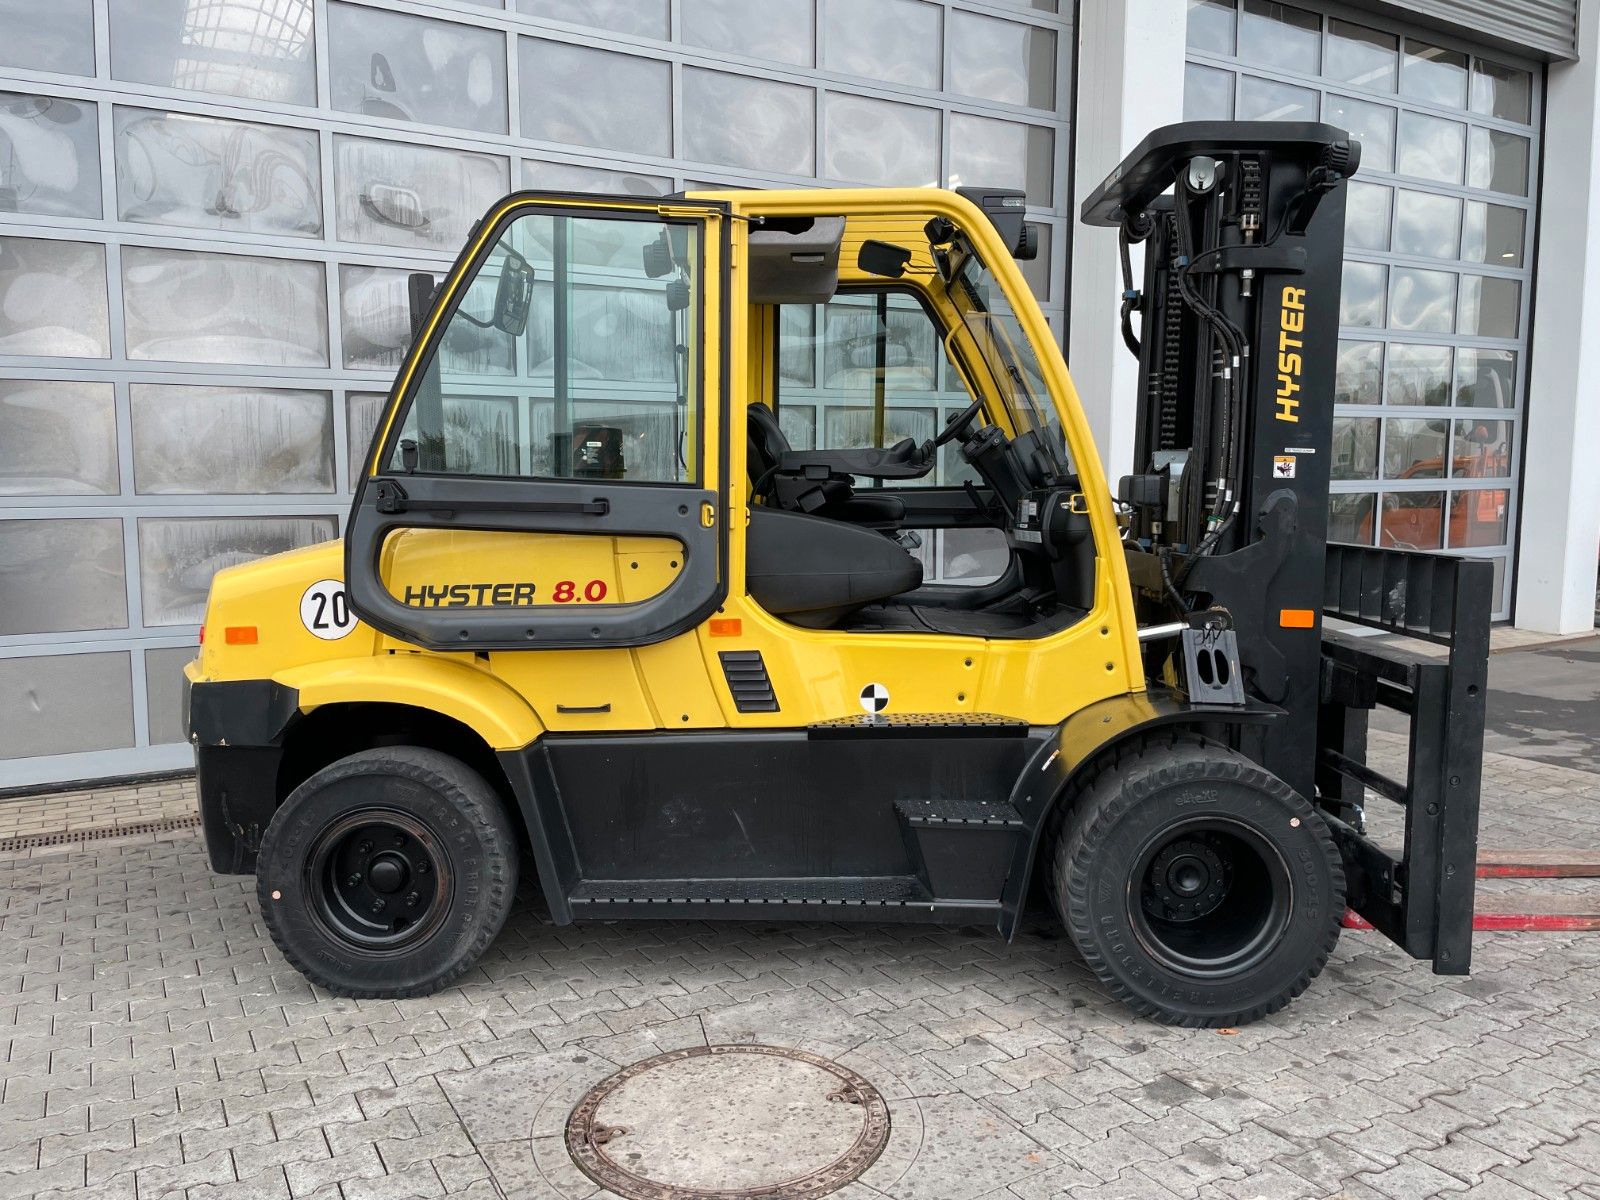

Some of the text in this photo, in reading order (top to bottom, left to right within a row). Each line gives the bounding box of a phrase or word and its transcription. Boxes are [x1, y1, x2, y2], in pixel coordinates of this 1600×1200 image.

[1275, 286, 1306, 423] HYSTER
[404, 583, 536, 606] HYSTER
[552, 579, 608, 603] 8.0
[311, 591, 349, 628] 20
